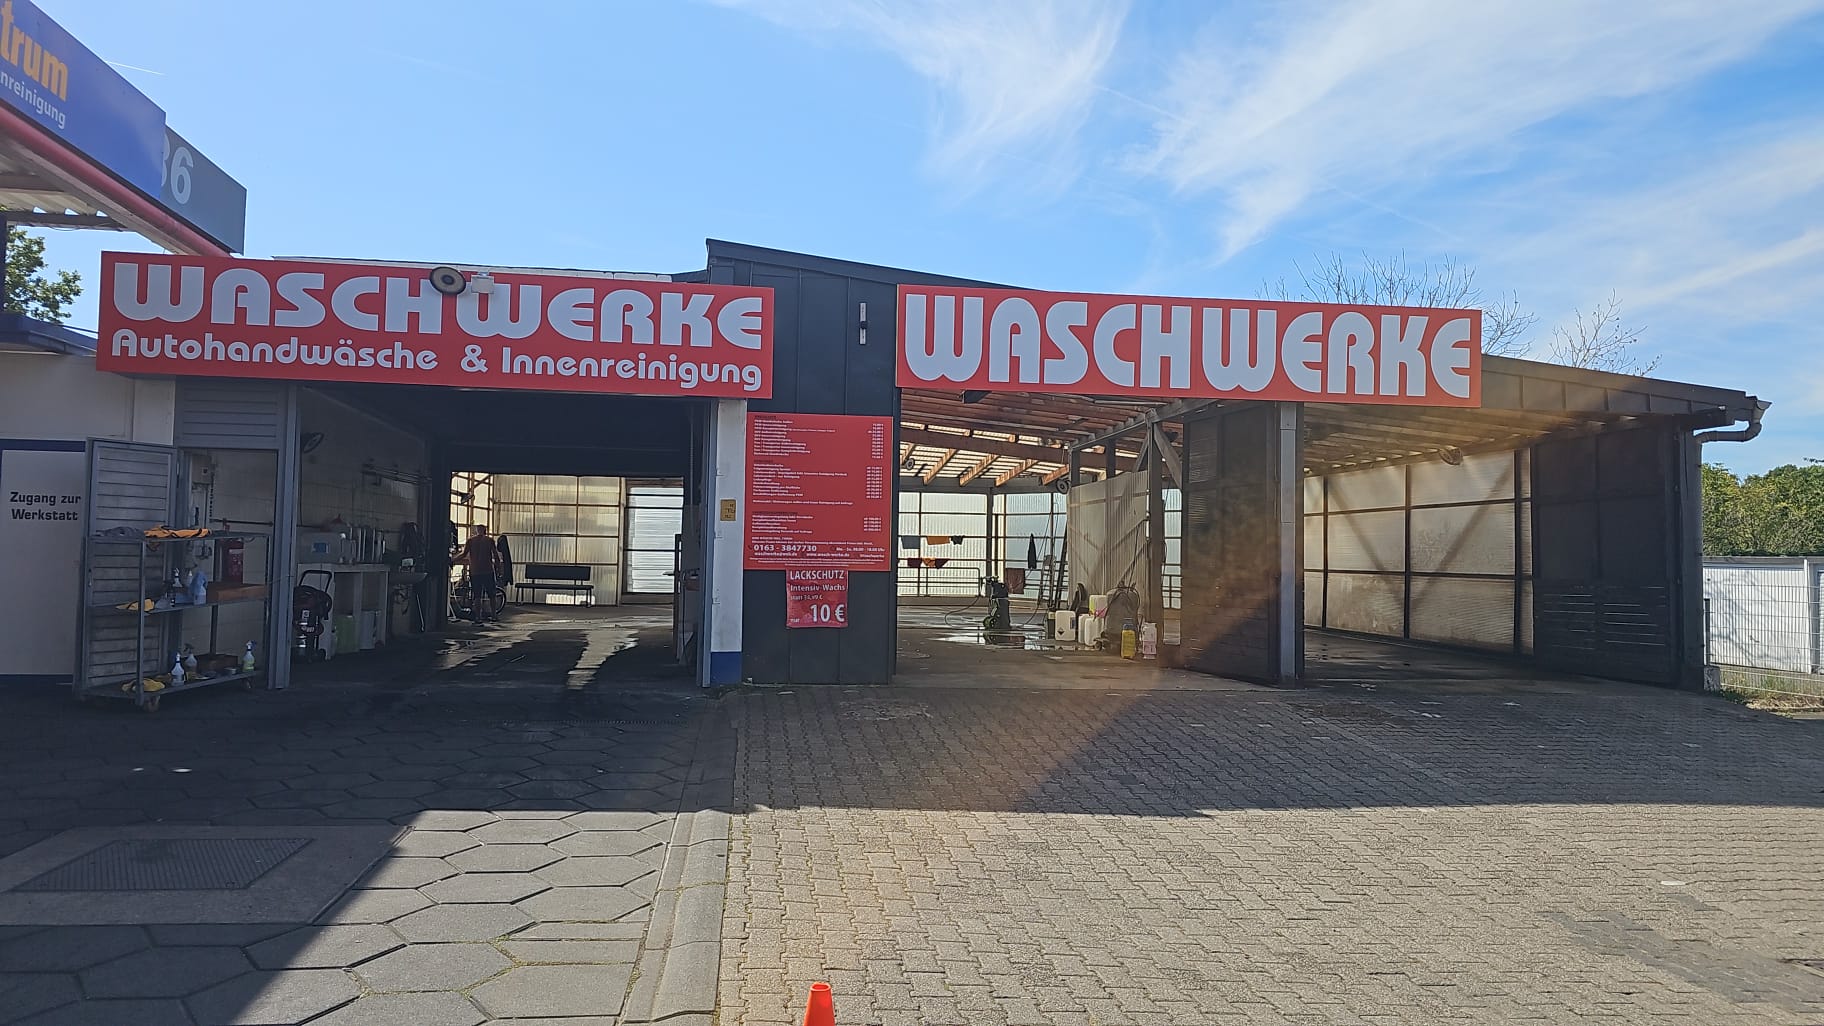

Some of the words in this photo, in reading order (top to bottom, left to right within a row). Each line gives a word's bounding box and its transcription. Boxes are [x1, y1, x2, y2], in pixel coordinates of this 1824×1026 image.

[0, 0, 68, 102] trum
[0, 71, 66, 130] nreinigung
[113, 262, 763, 350] WASCHWERKE
[111, 328, 438, 371] Autohandwäsche
[460, 344, 488, 373] &
[502, 346, 762, 392] Innenreinigung
[904, 293, 1472, 399] WASCHWERKE
[10, 491, 57, 506] Zugang
[61, 495, 81, 504] zur
[11, 508, 79, 521] Werkstatt
[790, 570, 845, 580] LACKSCHUTZ
[810, 604, 831, 622] 10
[834, 604, 845, 622] €
